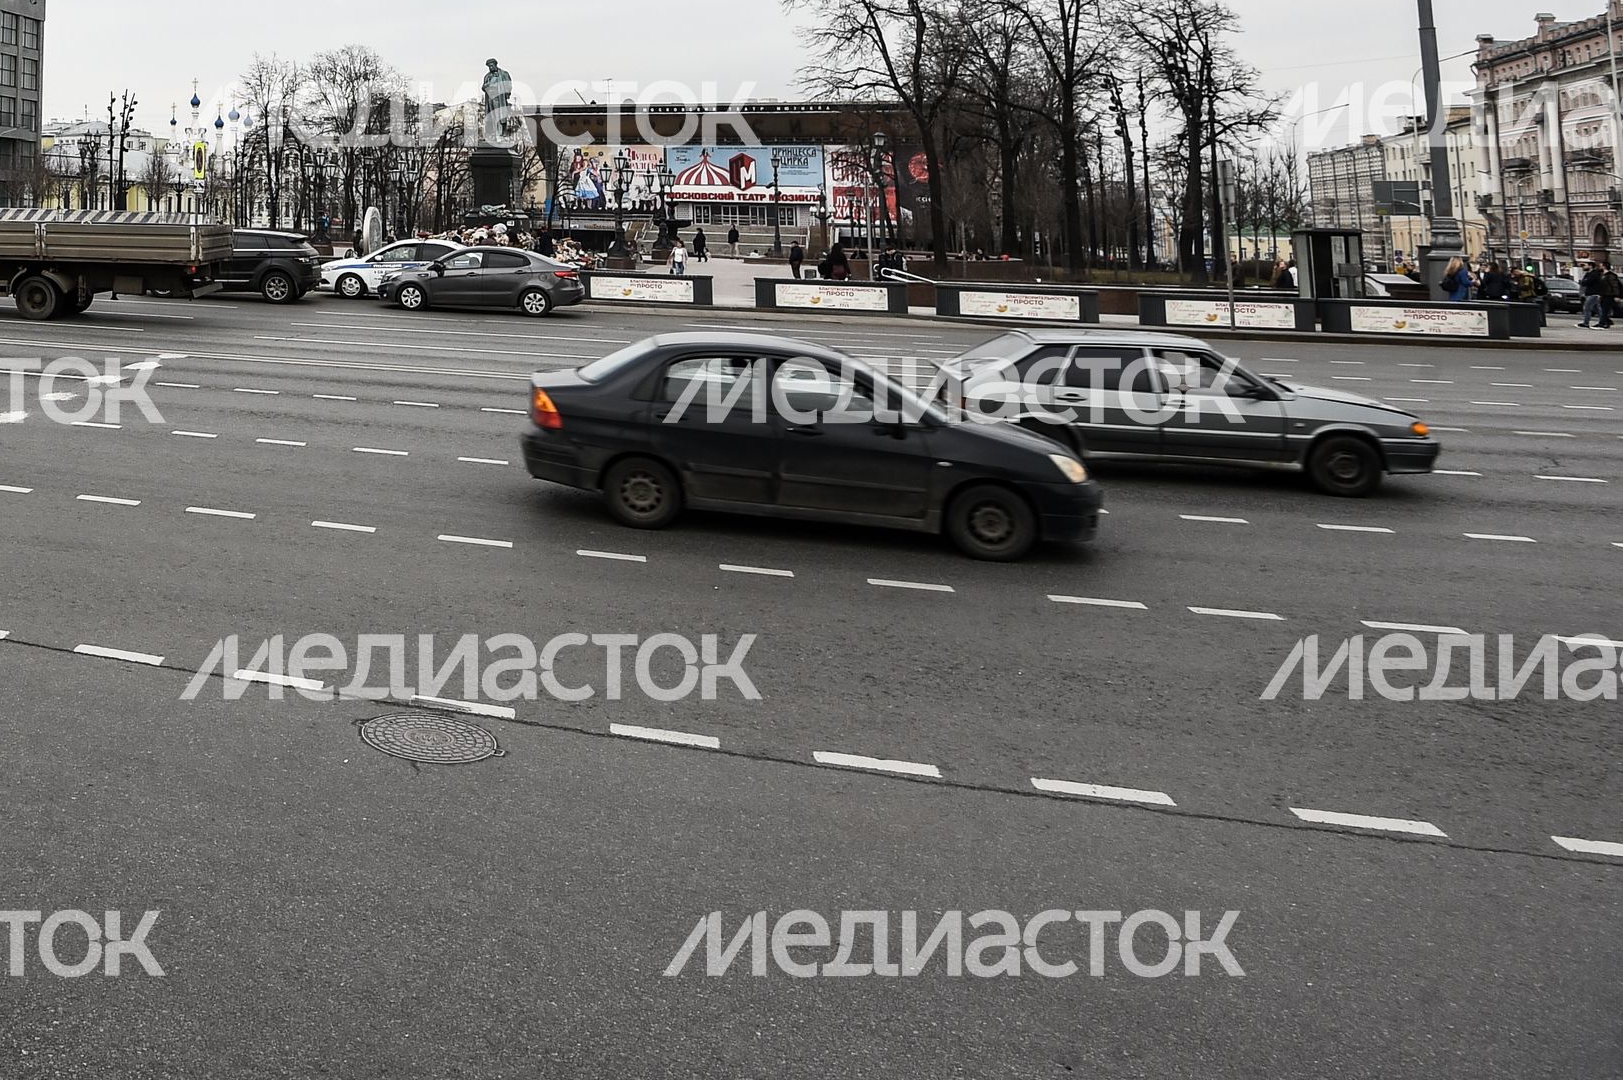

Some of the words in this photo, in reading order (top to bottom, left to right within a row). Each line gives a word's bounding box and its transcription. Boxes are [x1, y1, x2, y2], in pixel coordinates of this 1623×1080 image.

[772, 147, 817, 158] ПРИНЦЕССА
[780, 156, 809, 167] ЦИРКА
[666, 192, 735, 201] МОСКОВСКИЙ
[737, 193, 767, 202] ТЕАТР
